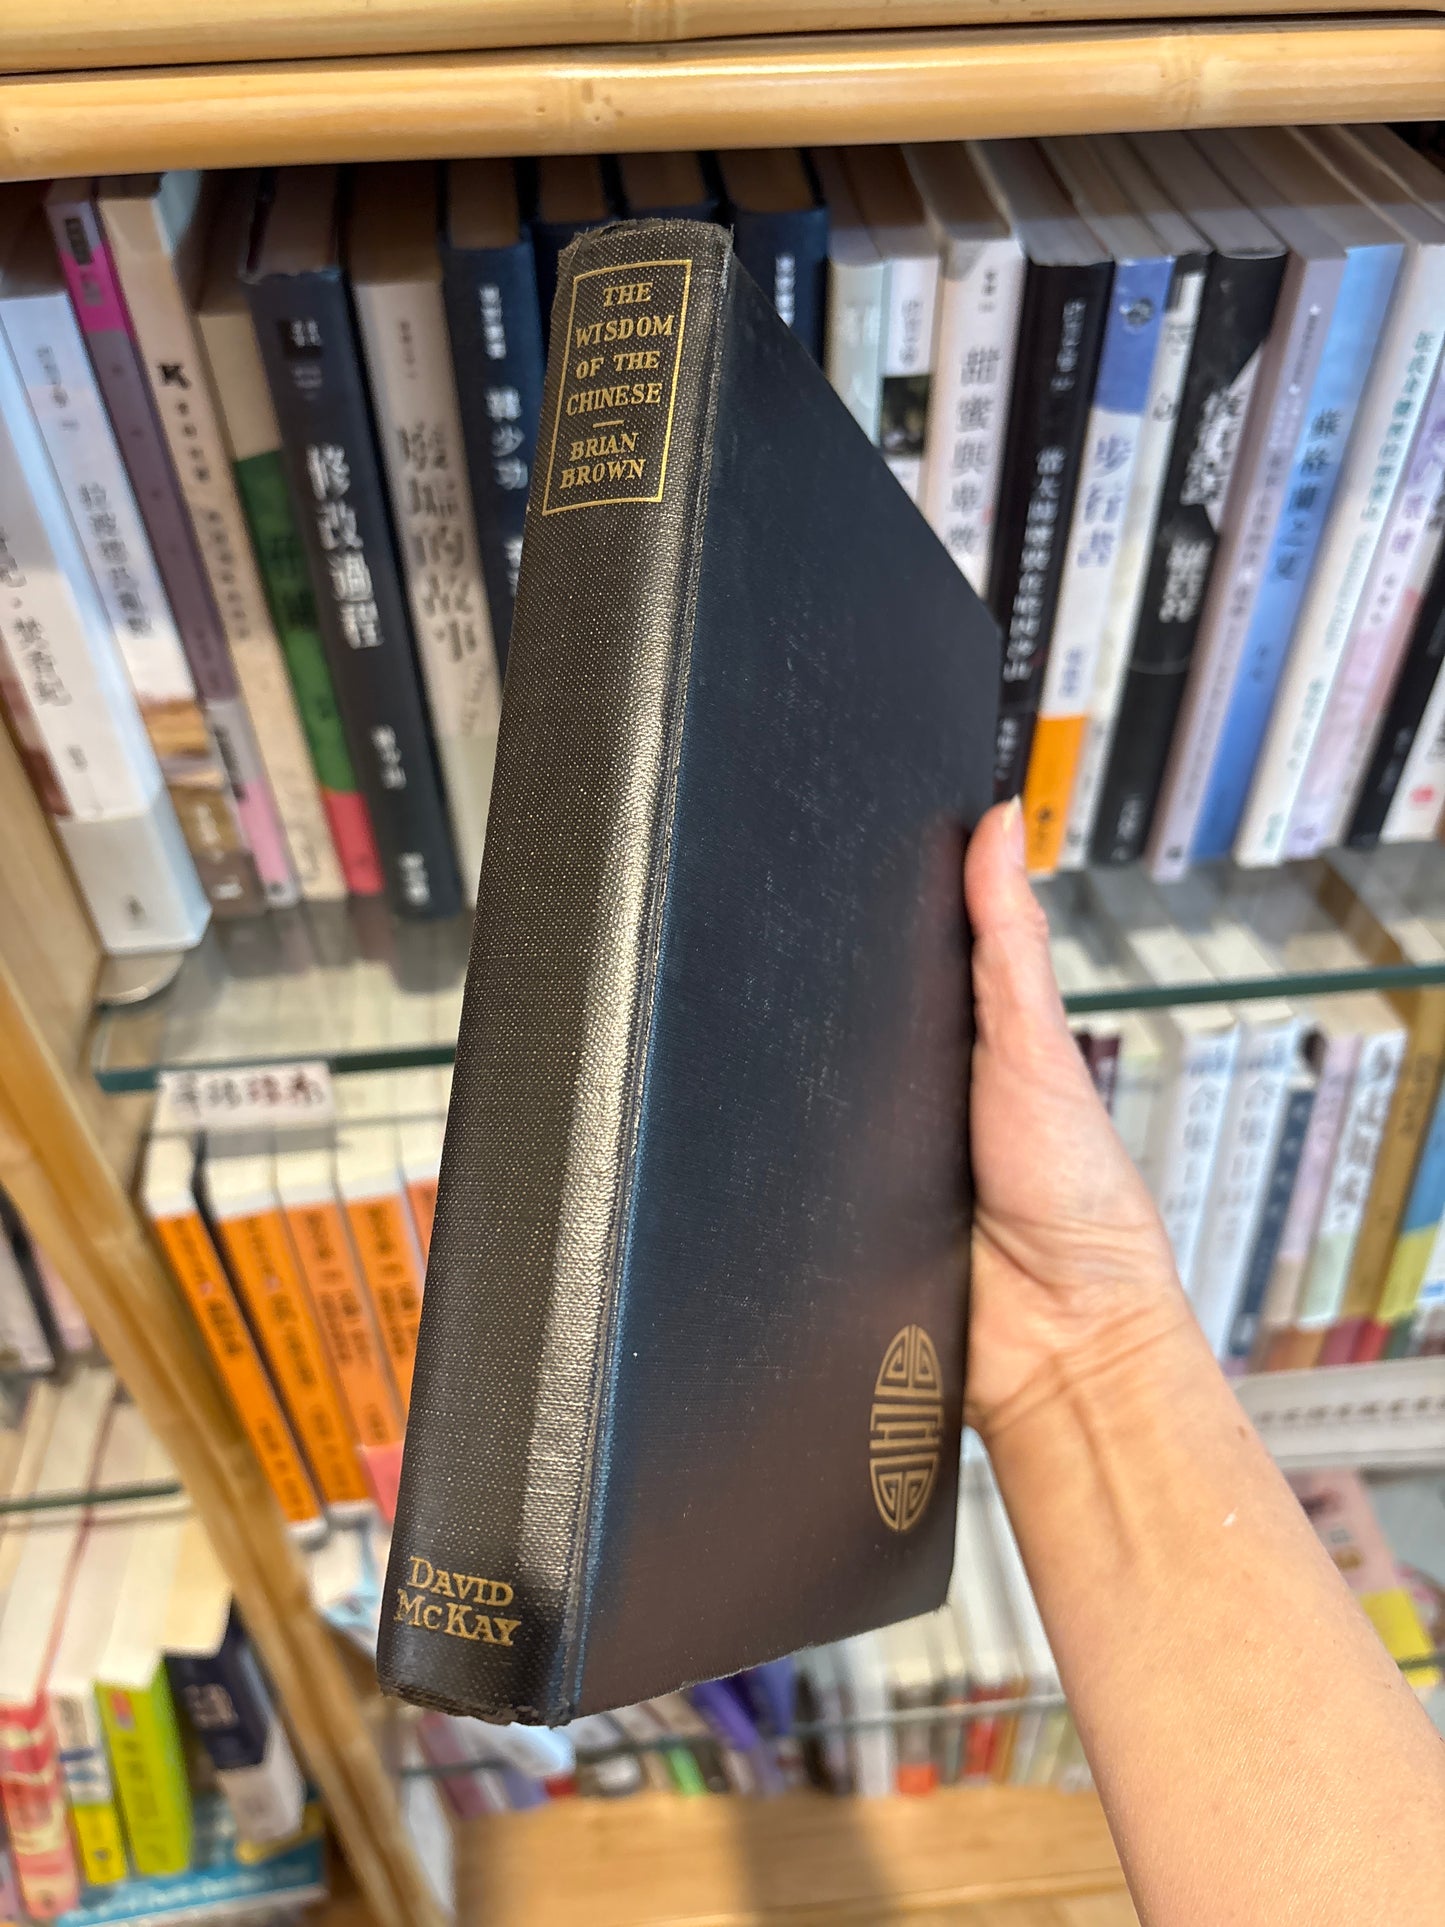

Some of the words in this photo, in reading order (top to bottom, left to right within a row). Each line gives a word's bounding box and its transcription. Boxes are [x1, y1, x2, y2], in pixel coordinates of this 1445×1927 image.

[603, 282, 653, 307] THE
[576, 314, 675, 348] WISDOM
[575, 356, 604, 380] OF
[613, 351, 661, 372] THE
[565, 382, 663, 417] CHINESE
[569, 432, 639, 462] BRIAN
[559, 458, 647, 490] BROWN
[407, 1556, 514, 1607] DAVID
